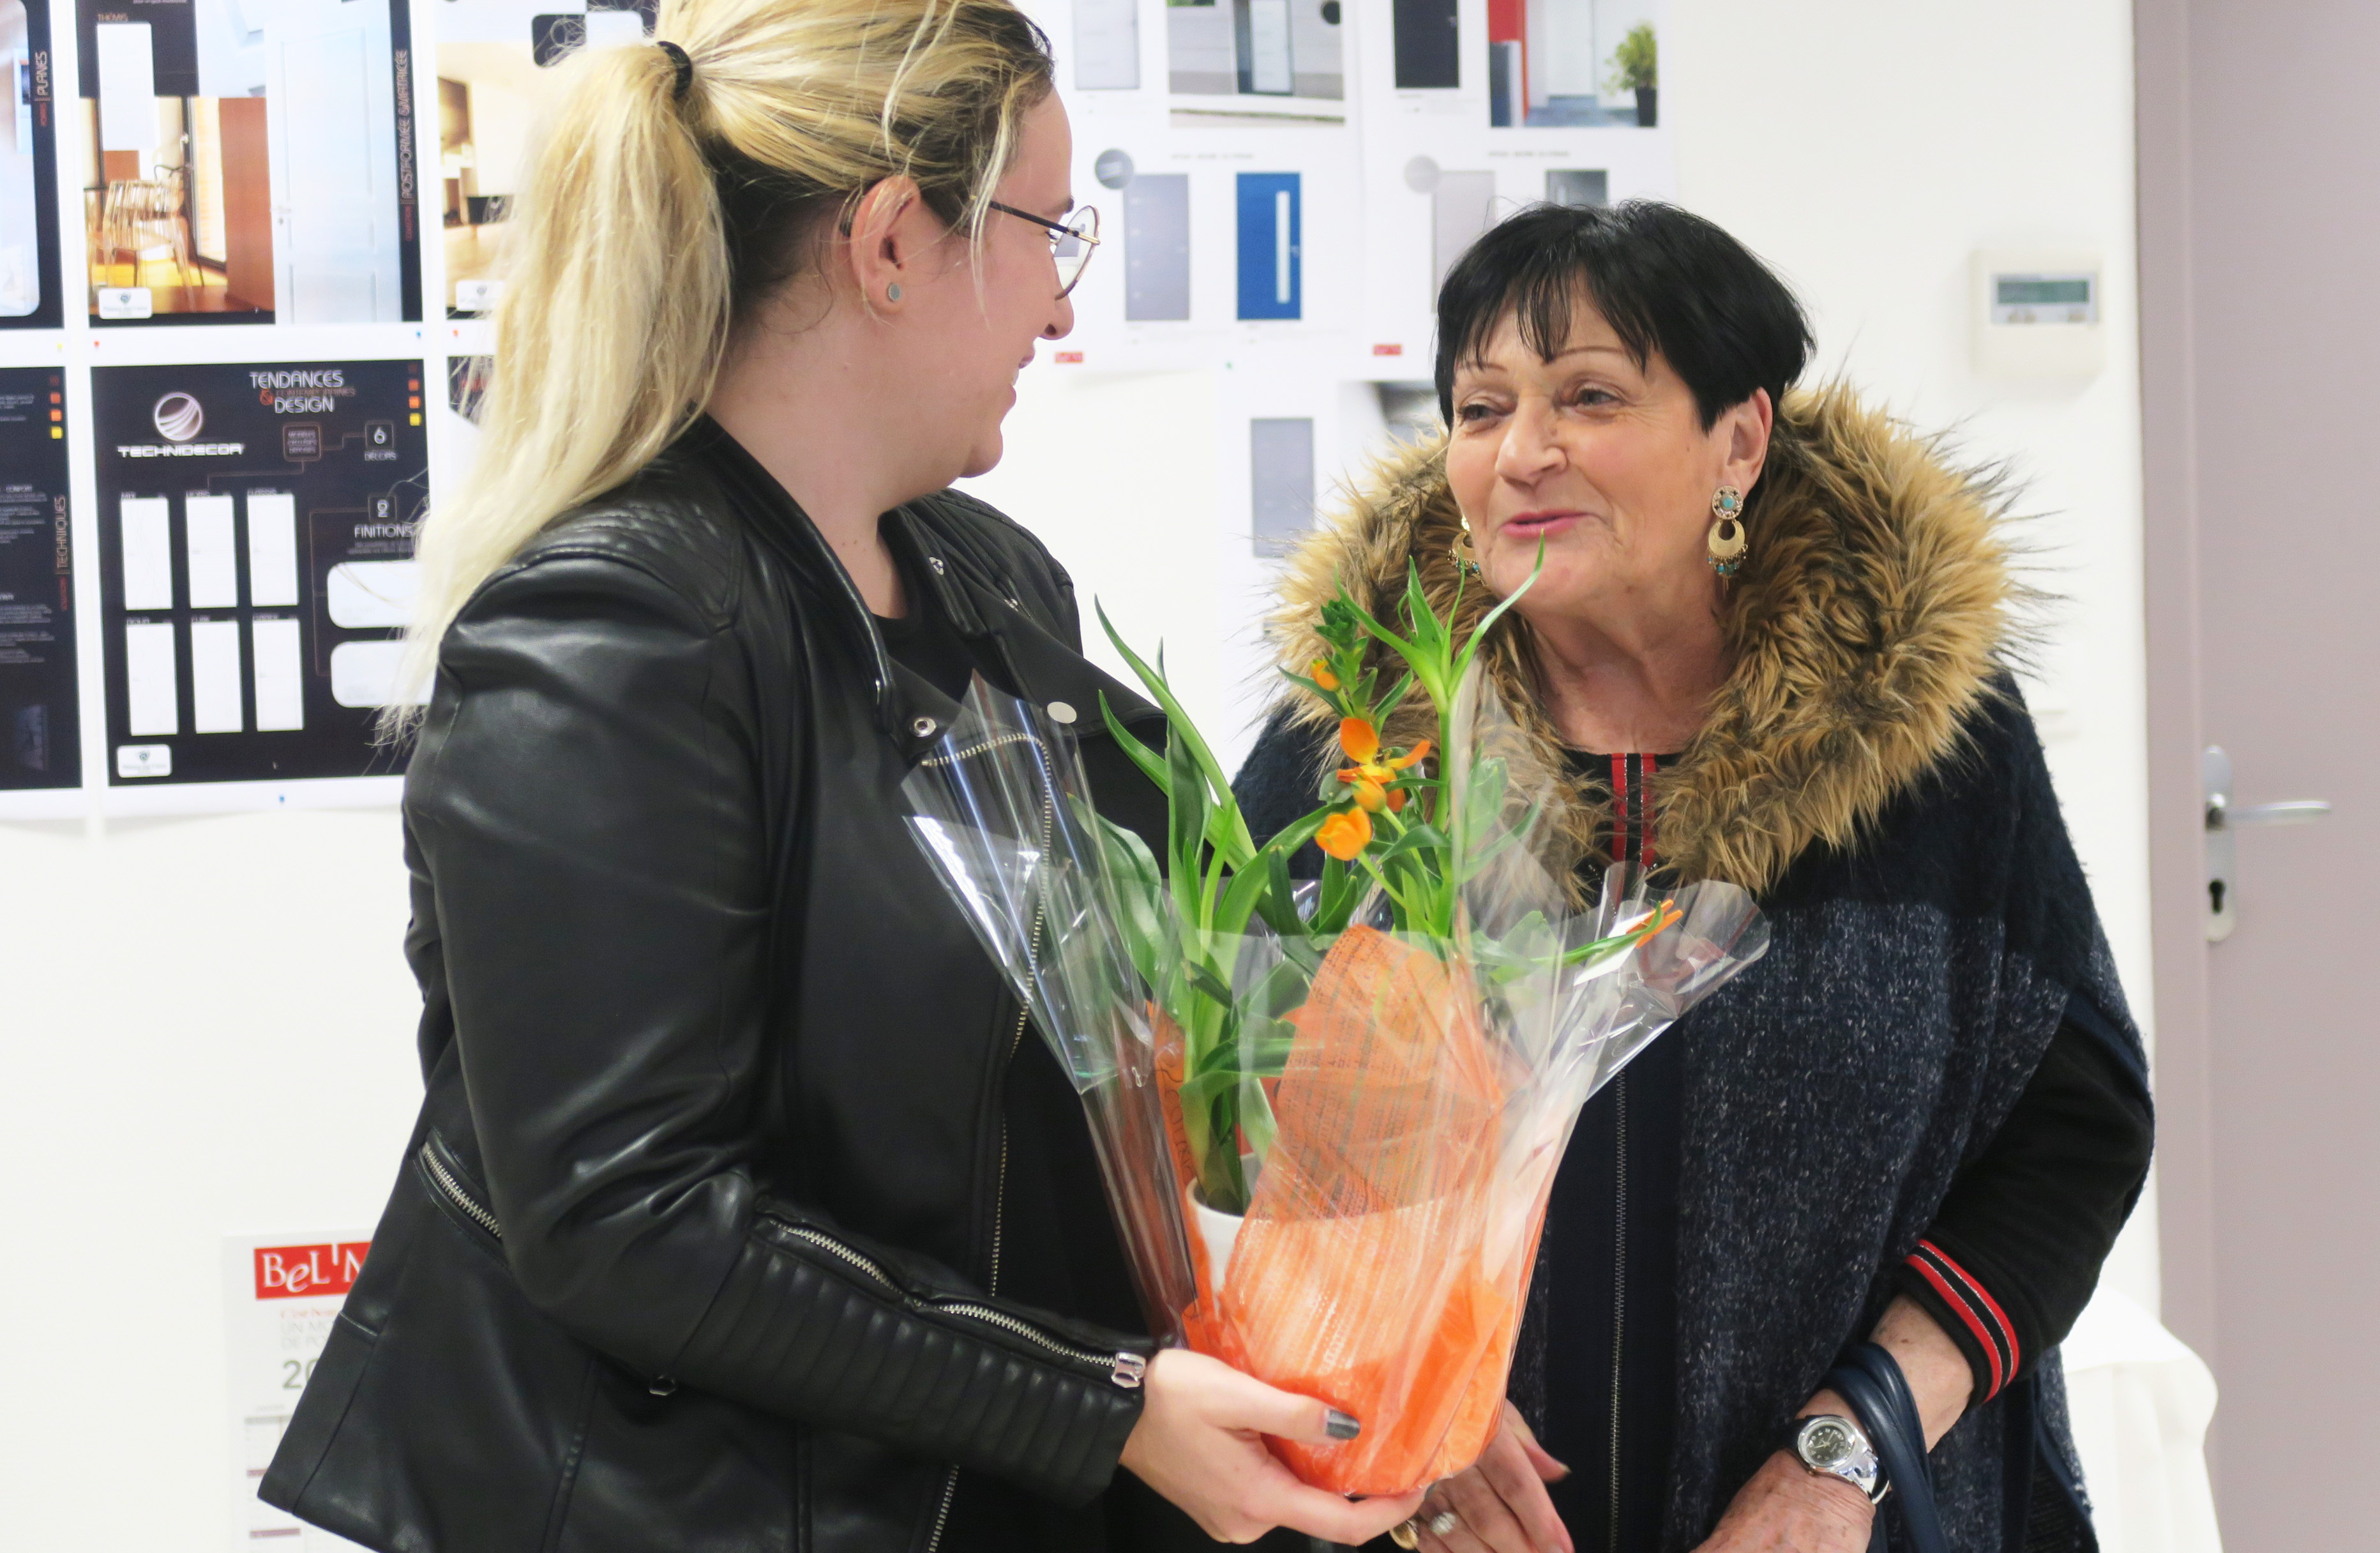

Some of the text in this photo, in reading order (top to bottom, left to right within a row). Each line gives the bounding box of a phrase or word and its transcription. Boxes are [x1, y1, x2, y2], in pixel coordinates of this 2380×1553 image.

[249, 370, 344, 389] TENDANCES
[275, 397, 334, 414] DESIGN
[374, 427, 387, 444] 6
[117, 443, 244, 458] TECHNIDECOR
[377, 499, 389, 518] 2
[54, 496, 68, 569] TECHNIQUES
[354, 523, 414, 538] FINITIONS
